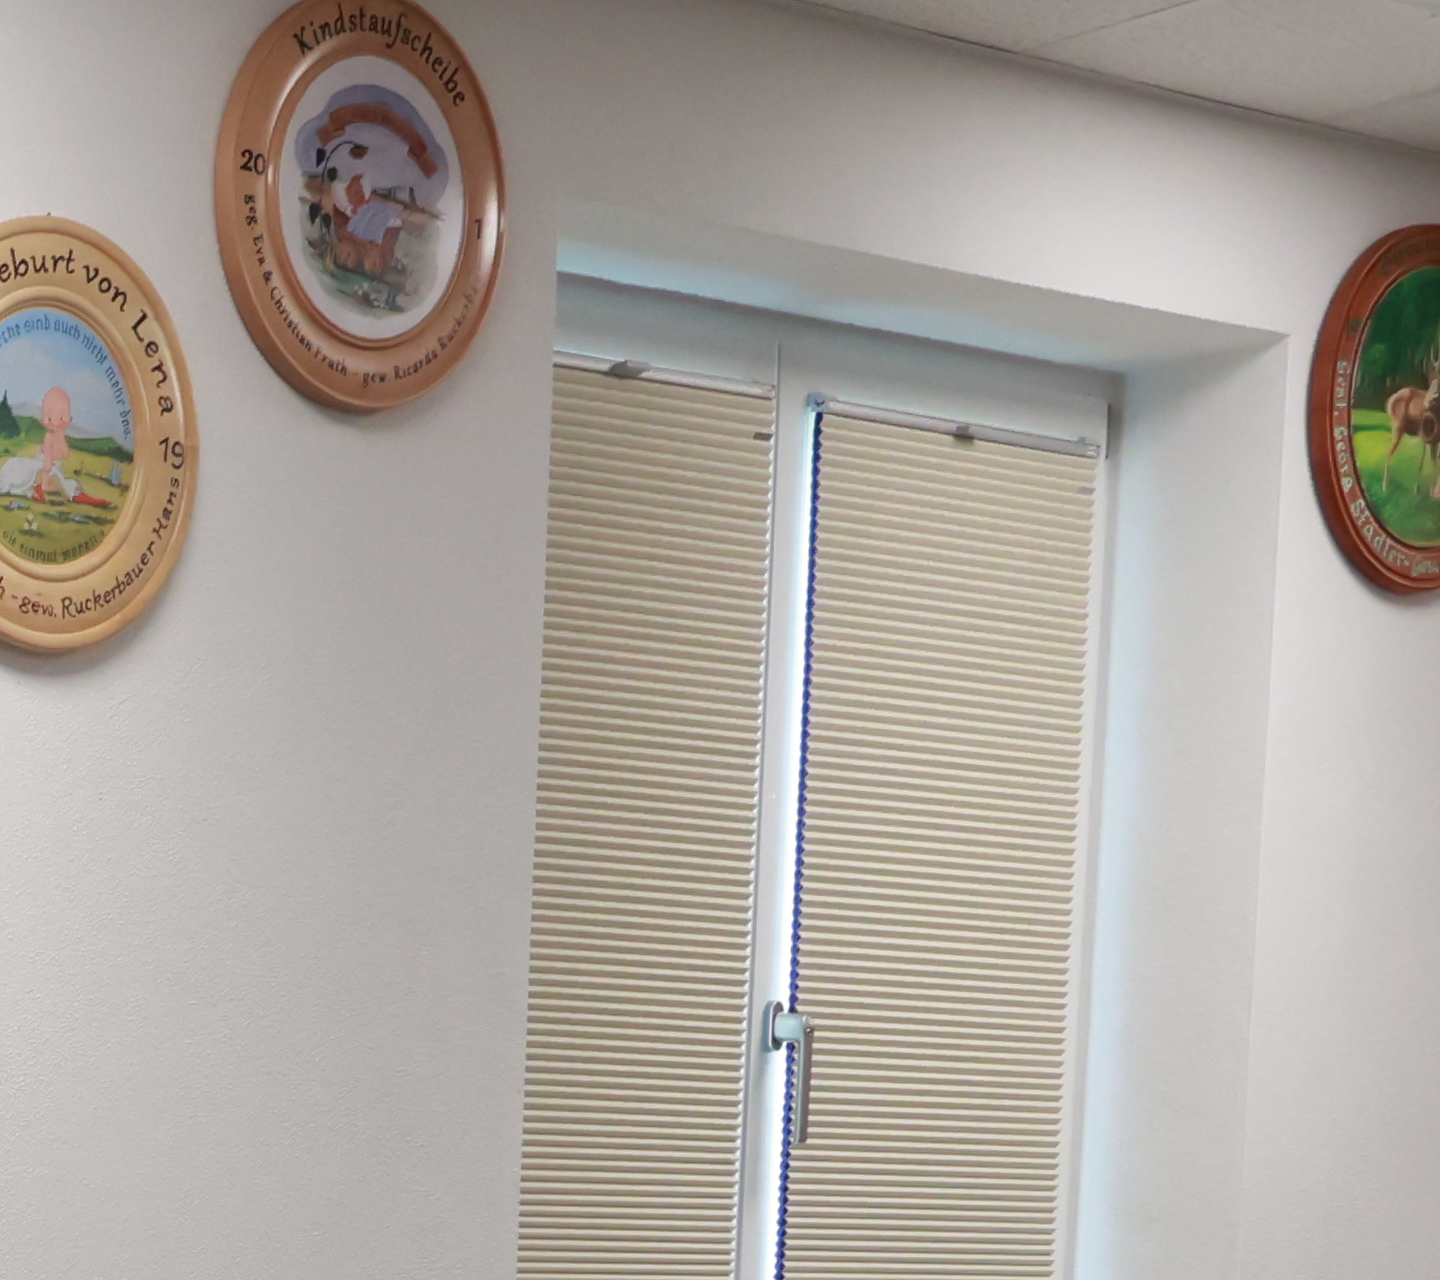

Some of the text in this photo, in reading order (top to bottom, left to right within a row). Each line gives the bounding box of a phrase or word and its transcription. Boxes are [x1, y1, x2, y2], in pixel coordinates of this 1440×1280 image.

[292, 3, 466, 108] Kindstaufscheibe
[239, 148, 267, 176] 20
[82, 263, 128, 312] von
[130, 308, 175, 417] Lena
[158, 436, 185, 470] 19
[60, 540, 156, 620] Ruckerbauer
[152, 475, 181, 540] Hans
